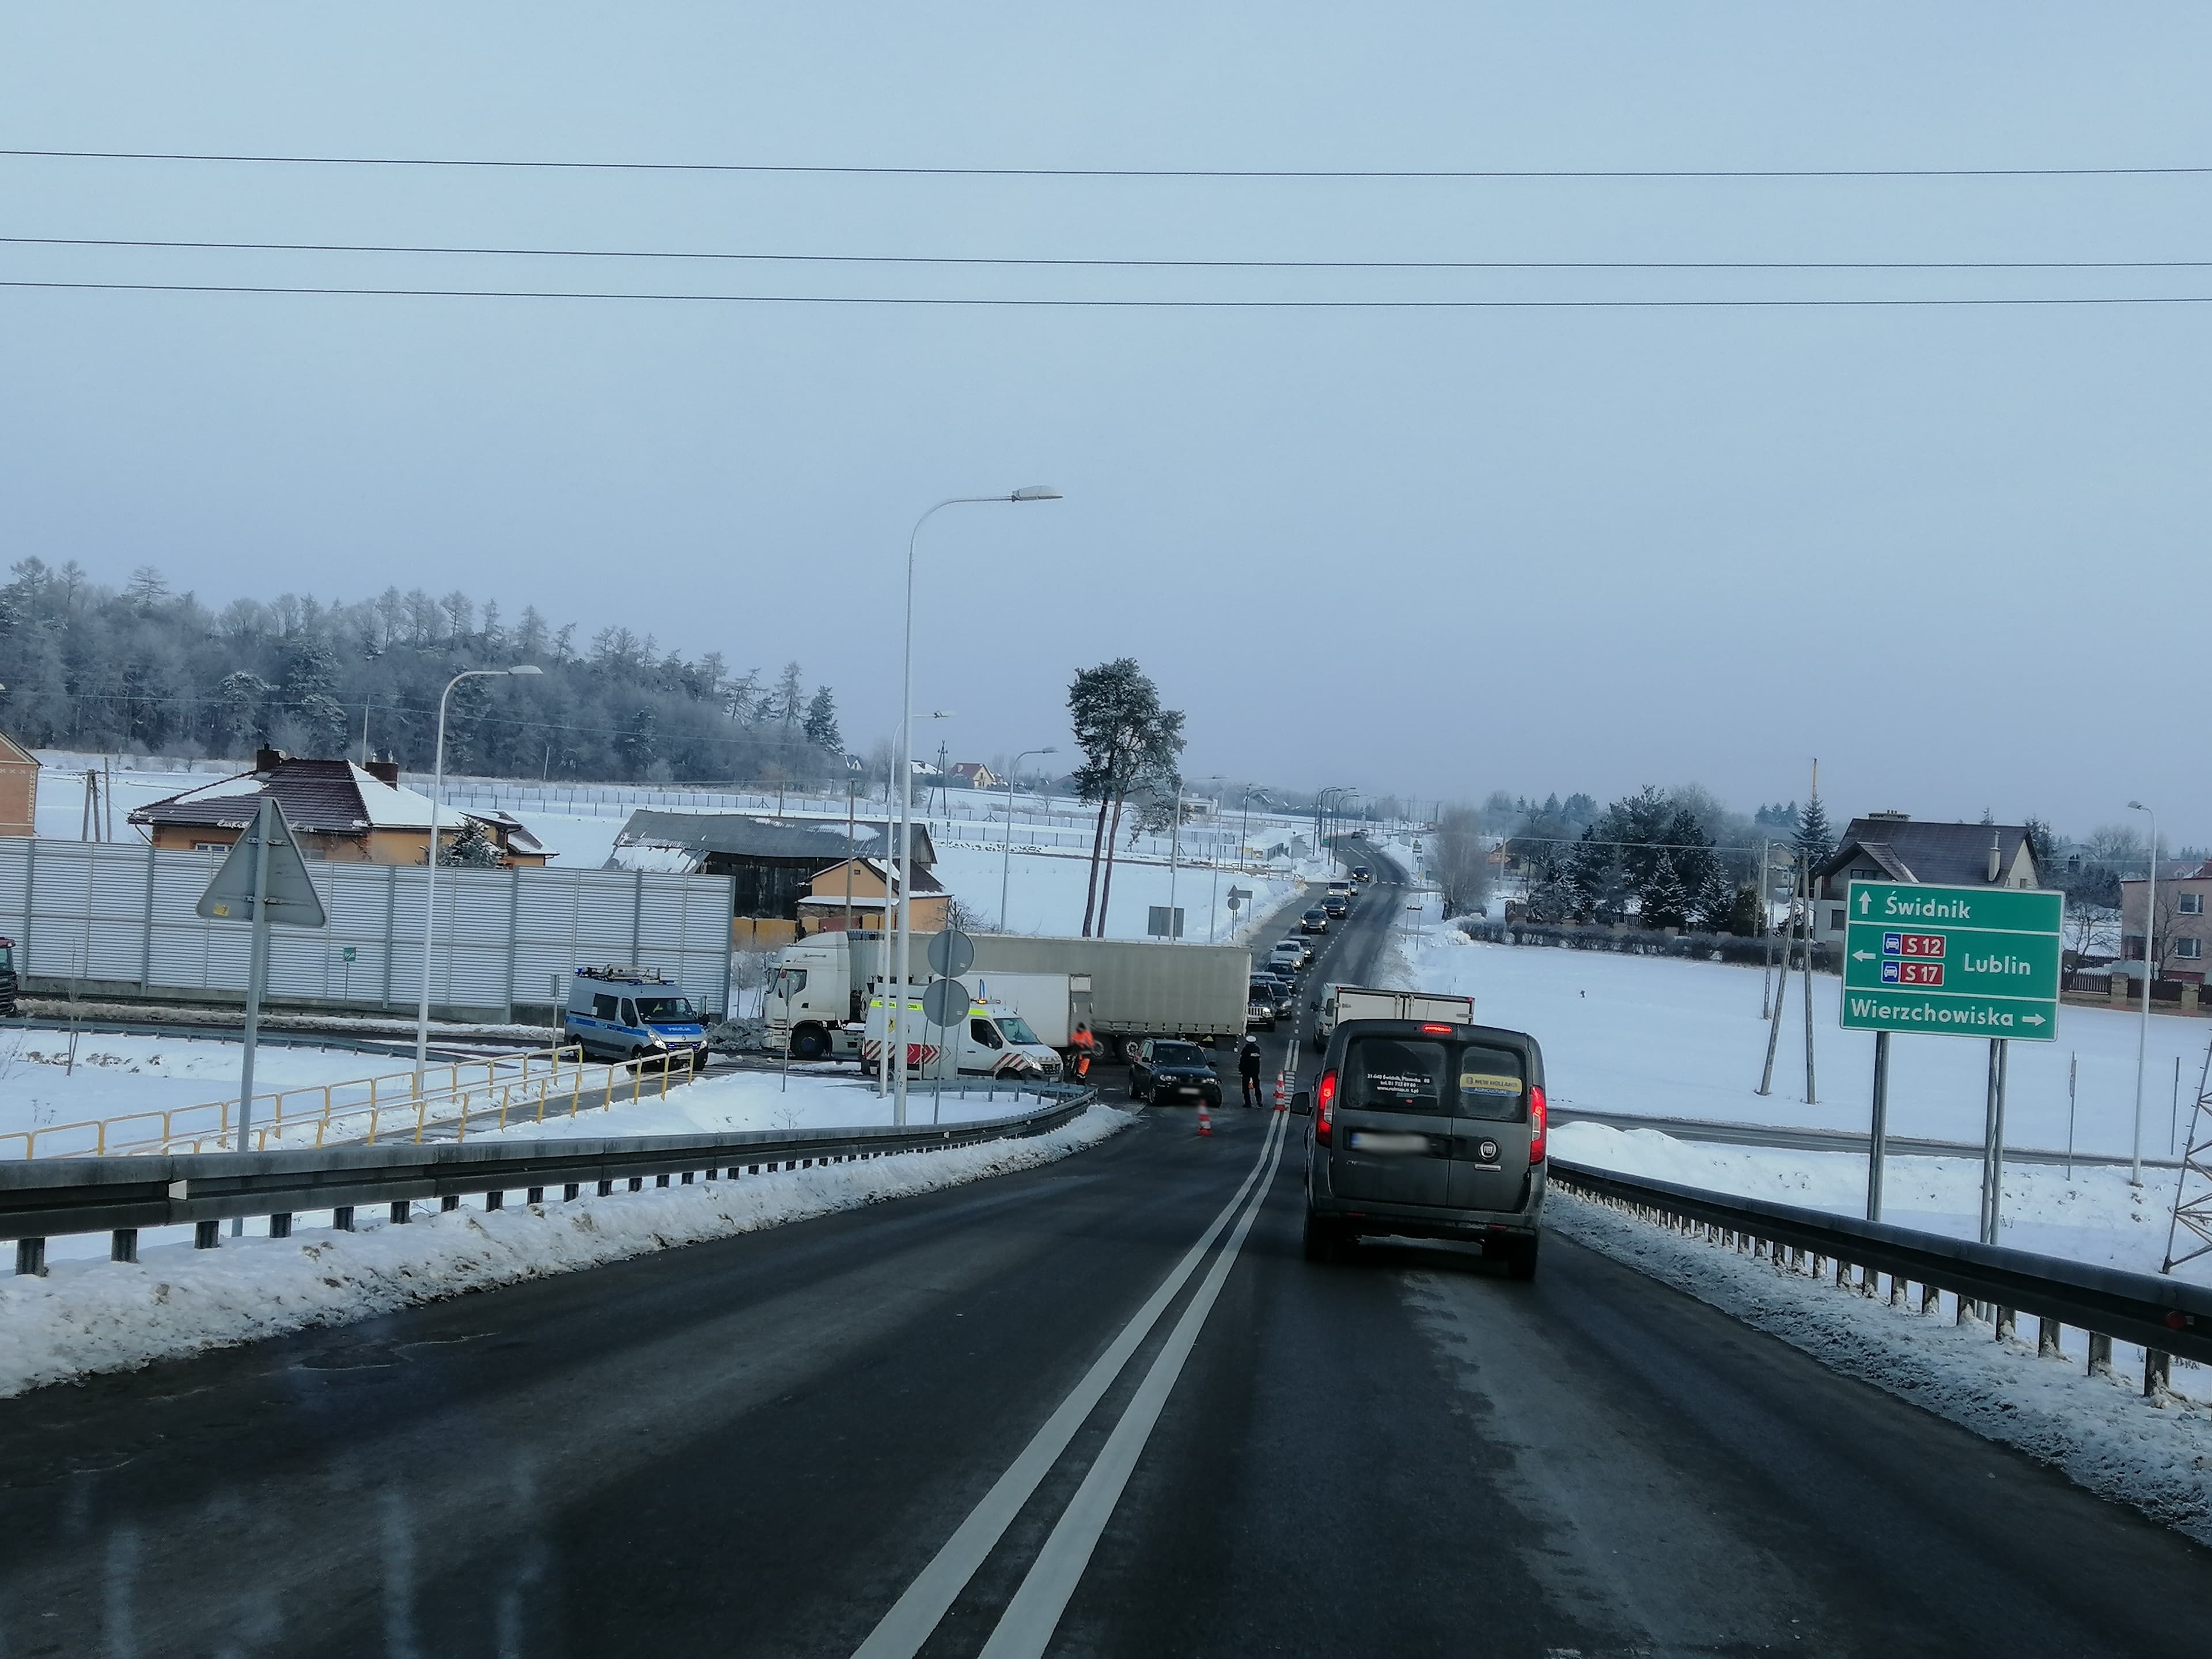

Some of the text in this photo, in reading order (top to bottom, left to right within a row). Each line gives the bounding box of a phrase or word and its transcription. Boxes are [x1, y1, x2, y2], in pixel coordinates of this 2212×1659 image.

[1885, 891, 1971, 918] Świdnik
[1907, 938, 1941, 954] S 12
[1905, 965, 1938, 982] S 17
[1964, 953, 2031, 975] Lublin
[1851, 998, 2014, 1027] Wierzchowiska
